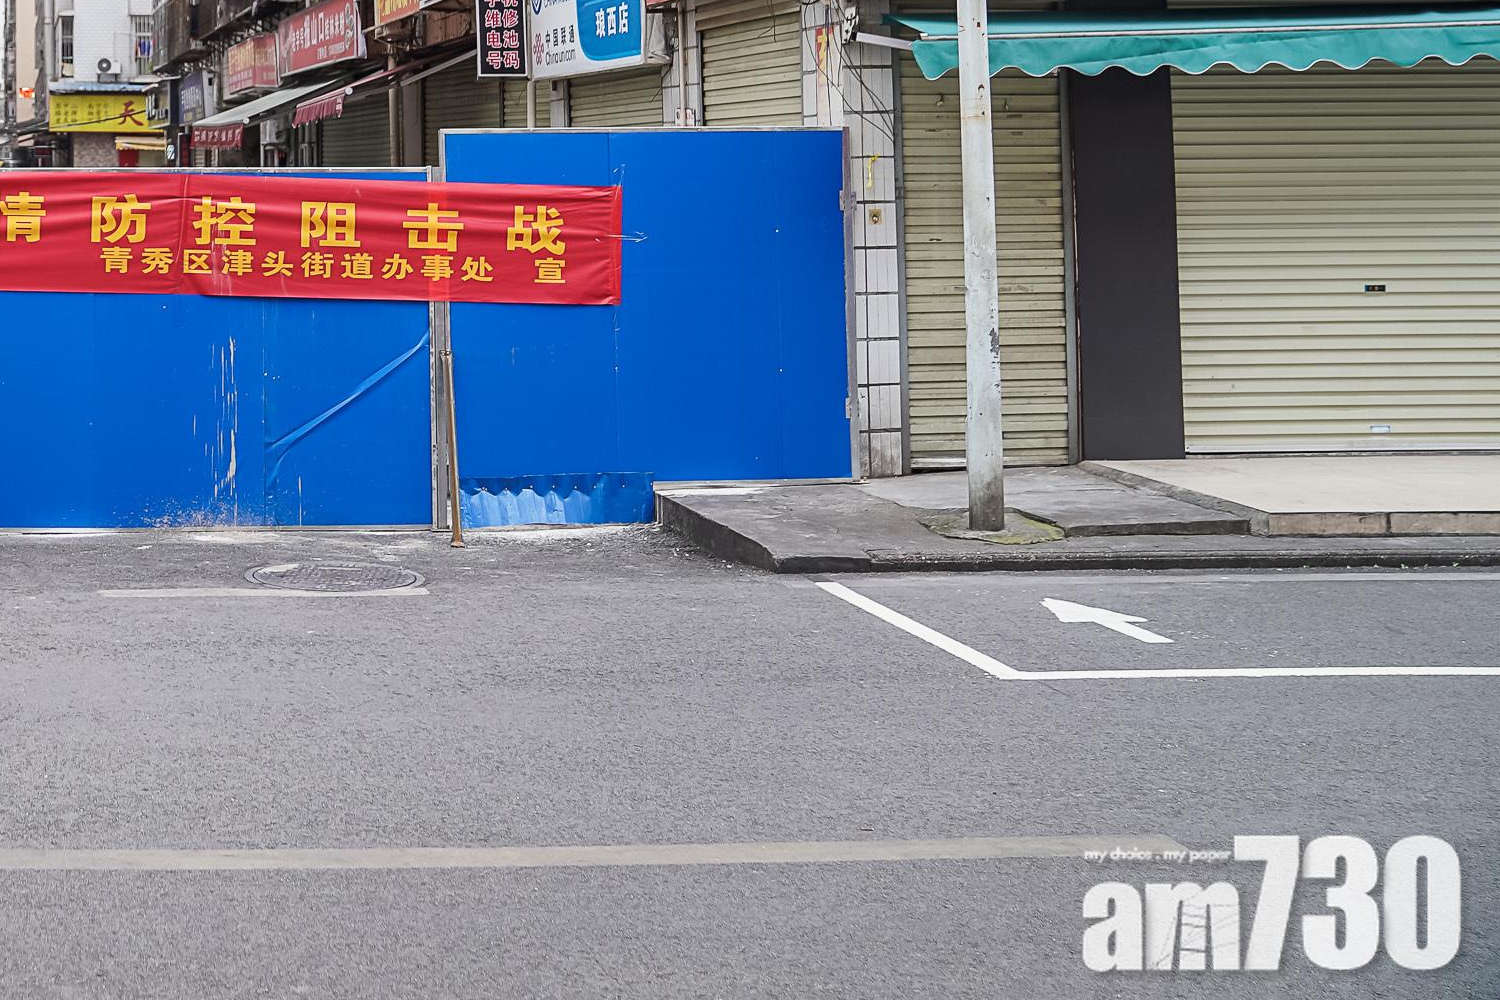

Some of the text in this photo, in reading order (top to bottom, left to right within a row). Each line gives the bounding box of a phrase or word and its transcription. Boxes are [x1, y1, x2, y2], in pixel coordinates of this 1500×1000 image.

[484, 9, 519, 29] 维修
[595, 1, 630, 39] 琅西店
[486, 30, 520, 49] 电池
[486, 50, 520, 70] 号码
[99, 245, 567, 284] 青秀区津头街道办事处 宣
